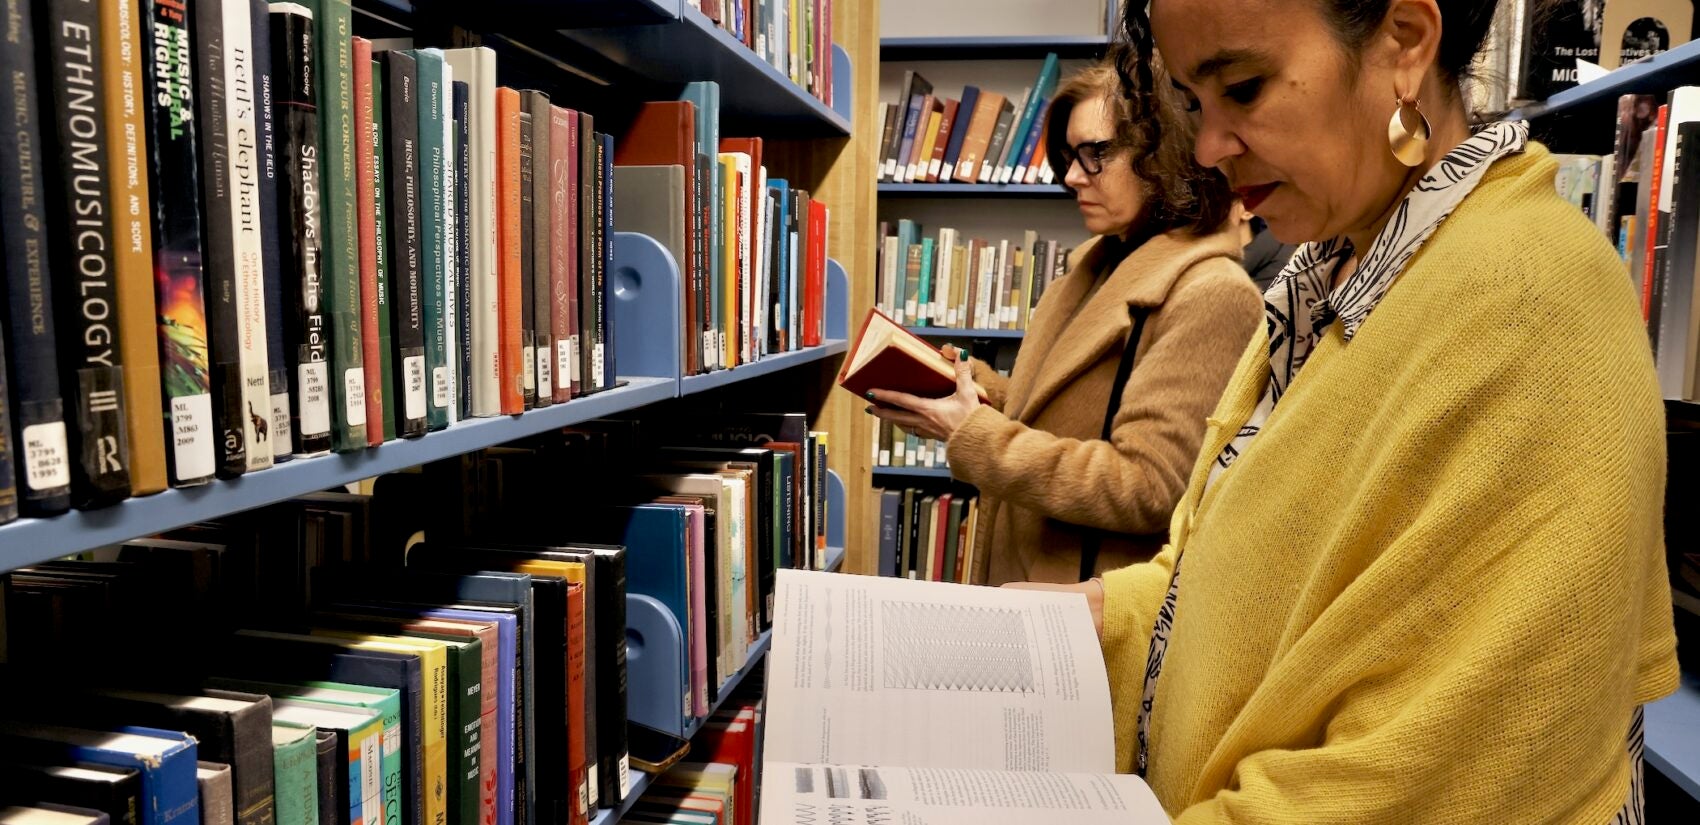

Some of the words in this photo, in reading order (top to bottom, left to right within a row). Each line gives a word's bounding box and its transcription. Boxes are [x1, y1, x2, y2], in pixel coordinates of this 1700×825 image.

[339, 15, 346, 35] TO
[154, 22, 171, 107] RIGHTS
[177, 28, 190, 100] MUSIC
[208, 39, 222, 70] The
[303, 55, 310, 63] &
[339, 39, 347, 68] THE
[1555, 46, 1574, 57] The
[1575, 47, 1598, 57] Lost
[12, 70, 28, 127] MUSIC,
[120, 71, 134, 119] HISTORY,
[169, 26, 184, 141] CULTURAL
[234, 48, 252, 119] nettl's
[262, 74, 270, 120] SHADOWS
[340, 71, 349, 109] FOUR
[180, 108, 191, 122] &
[211, 77, 225, 137] Musical
[264, 122, 272, 131] IN
[124, 123, 139, 189] DEFINITIONS,
[265, 134, 273, 151] THE
[342, 112, 351, 181] CORNERS:
[405, 139, 413, 173] MUSIC,
[17, 131, 35, 210] CULTURE,
[212, 141, 228, 198] Human
[236, 128, 254, 233] elephant
[266, 153, 274, 178] FIELD
[302, 144, 317, 239] Shadows
[345, 187, 353, 198] A
[431, 147, 440, 222] Philosophical
[62, 20, 113, 367] ETHNOMUSICOLOGY
[89, 390, 118, 412] III
[129, 195, 140, 215] AND
[406, 175, 416, 244] PHILOSOPHY,
[24, 213, 39, 232] &
[131, 221, 143, 253] SCOPE
[375, 187, 381, 198] ON
[378, 269, 384, 279] OF
[242, 252, 248, 262] of
[251, 252, 258, 265] On
[304, 247, 318, 264] in
[349, 264, 357, 275] in
[408, 246, 417, 267] AND
[433, 225, 442, 297] Perspectives
[26, 239, 45, 336] EXPERIENCE
[307, 272, 320, 307] the
[350, 279, 358, 315] Honor
[409, 270, 418, 330] MODERNITY
[242, 264, 253, 350] Ethnomusicology
[252, 287, 260, 323] History
[436, 300, 442, 313] on
[308, 315, 323, 362] Field
[247, 377, 264, 387] Nettl
[174, 403, 189, 412] ML
[176, 414, 193, 423] 3799
[176, 424, 199, 434] .M863
[177, 437, 195, 446] 2009
[31, 448, 55, 458] 3799
[32, 468, 57, 479] 1995
[467, 683, 480, 696] MEYER
[463, 741, 481, 758] MEANING
[469, 732, 479, 743] AND
[467, 766, 479, 780] MUSIC
[471, 756, 476, 766] IN
